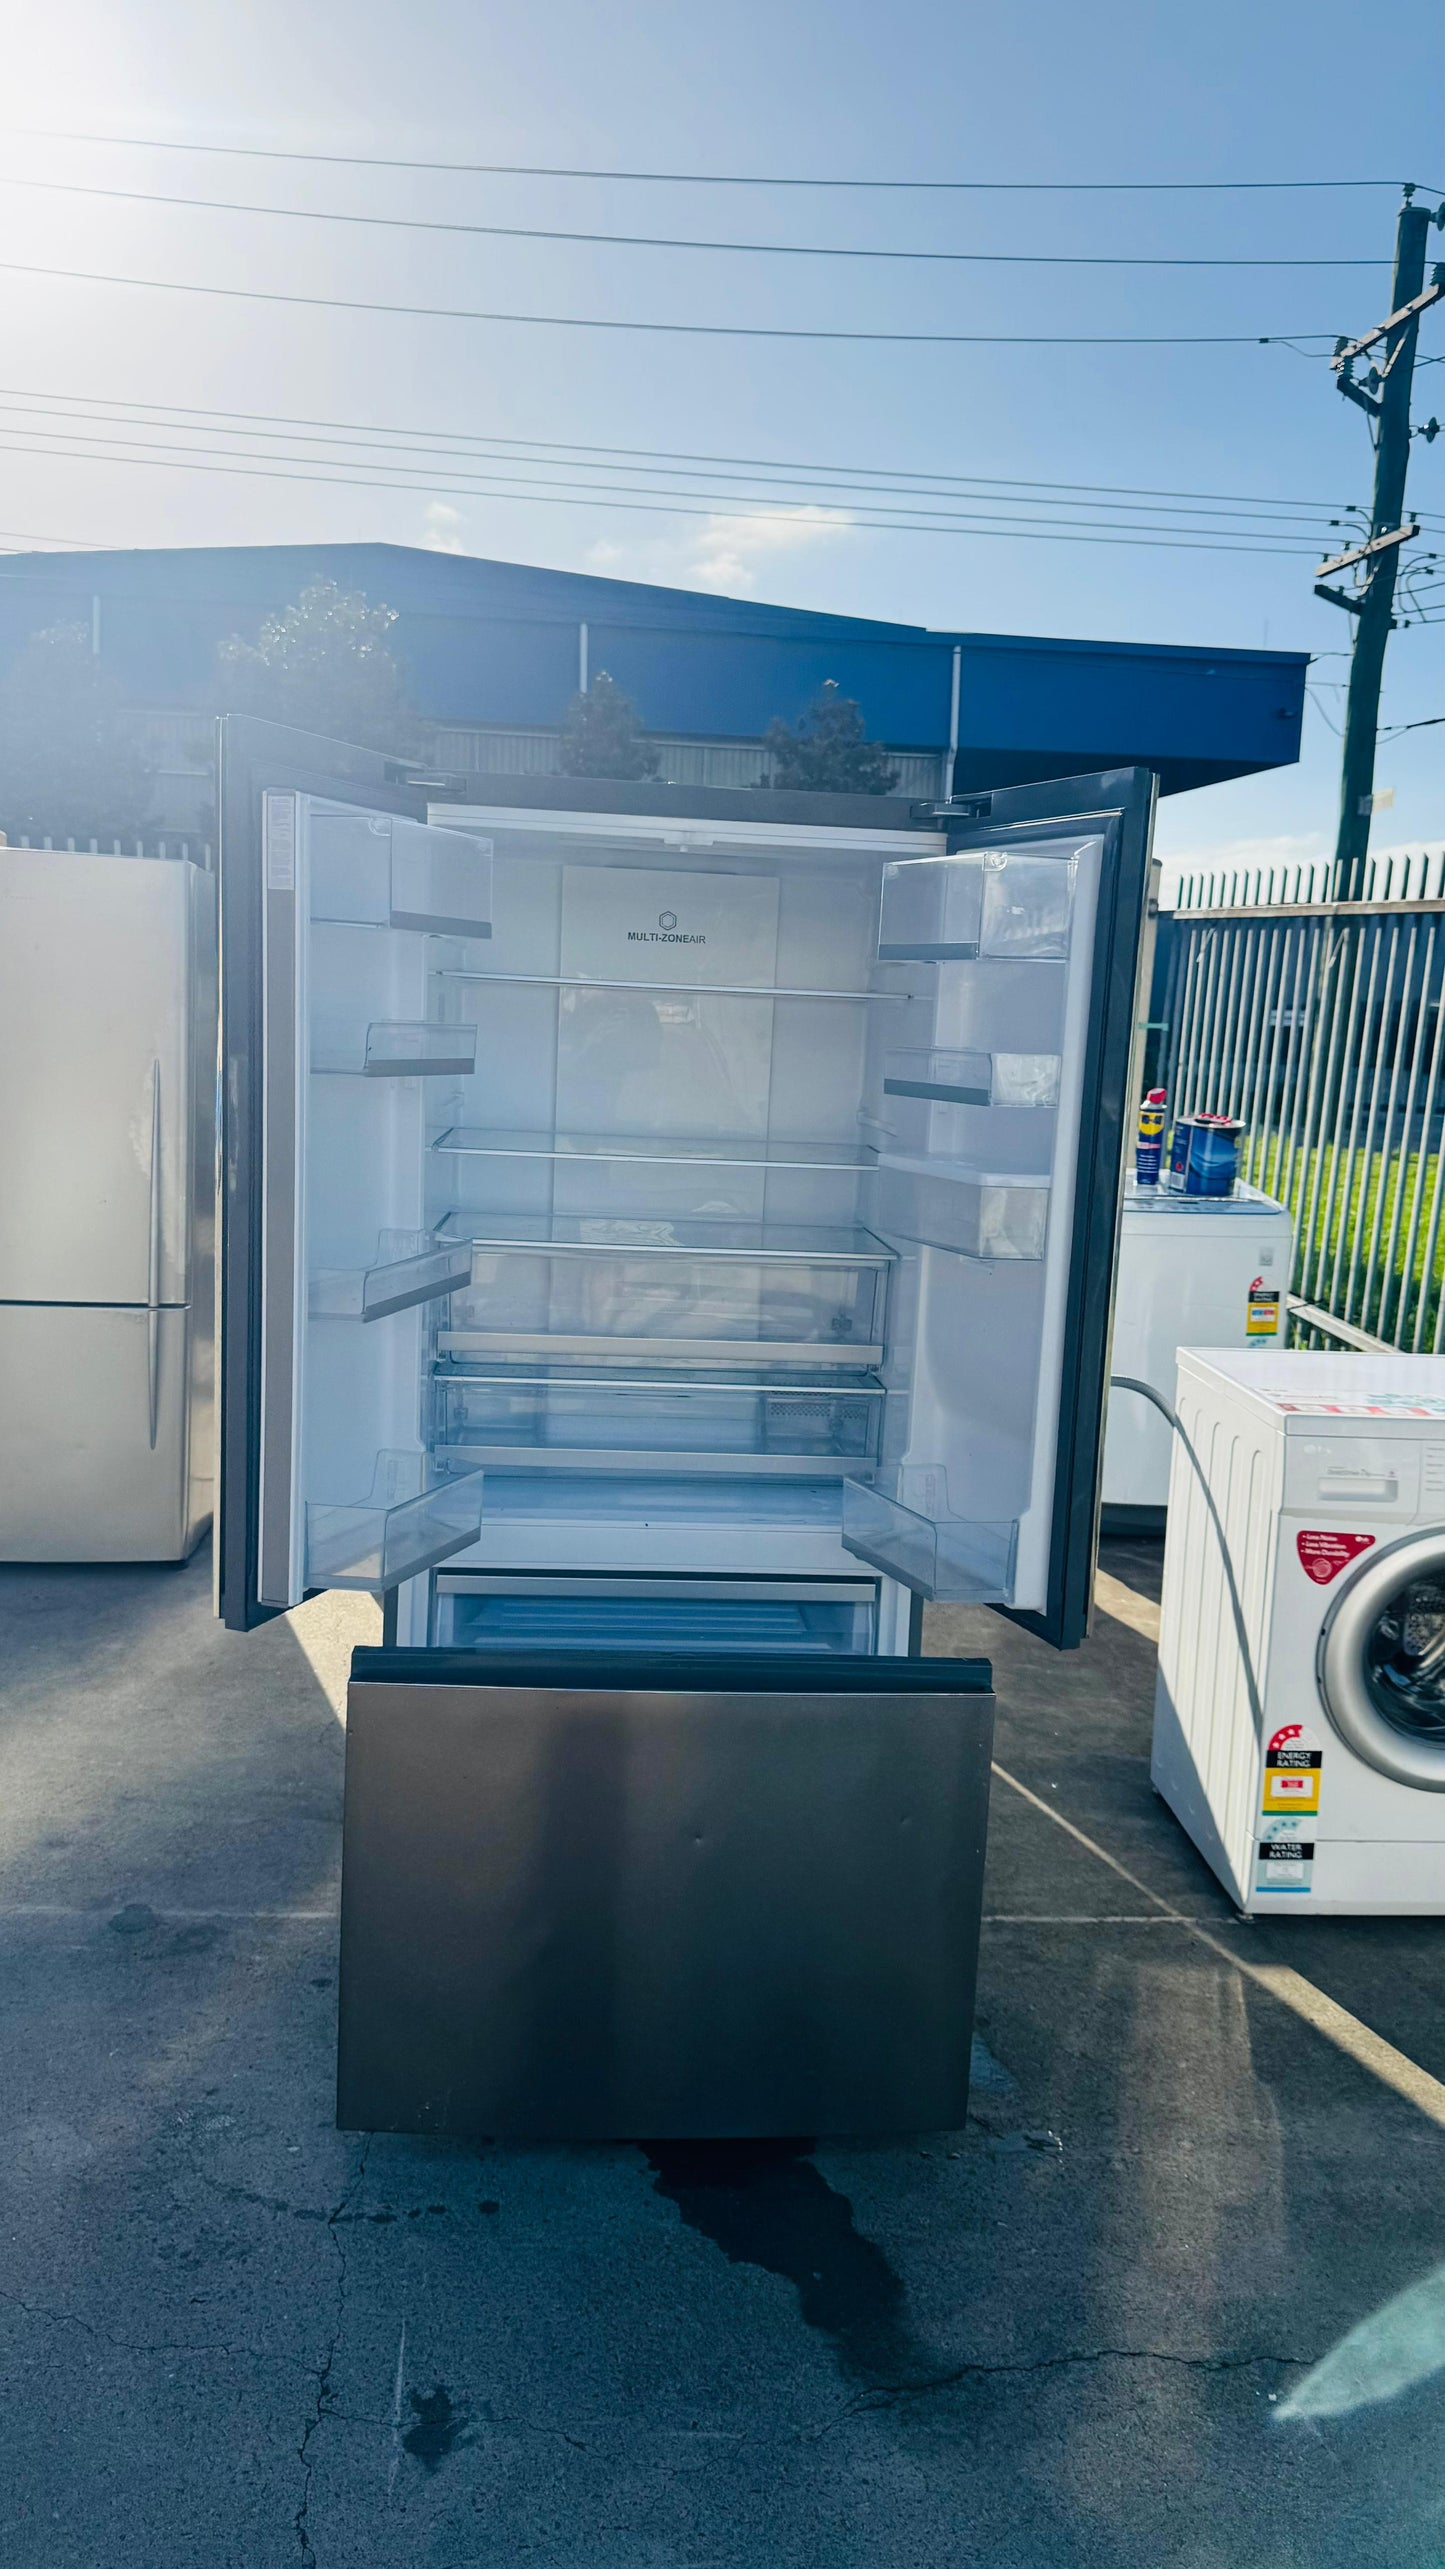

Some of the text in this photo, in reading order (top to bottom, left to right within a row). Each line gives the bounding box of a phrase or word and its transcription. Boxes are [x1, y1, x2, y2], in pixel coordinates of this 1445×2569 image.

[627, 931, 706, 944] MULTI-ZONEAIR
[1277, 1751, 1312, 1760] ENERGY
[1276, 1760, 1311, 1768] RATING
[1270, 1843, 1303, 1851] WATER
[1268, 1850, 1303, 1859] RATING
